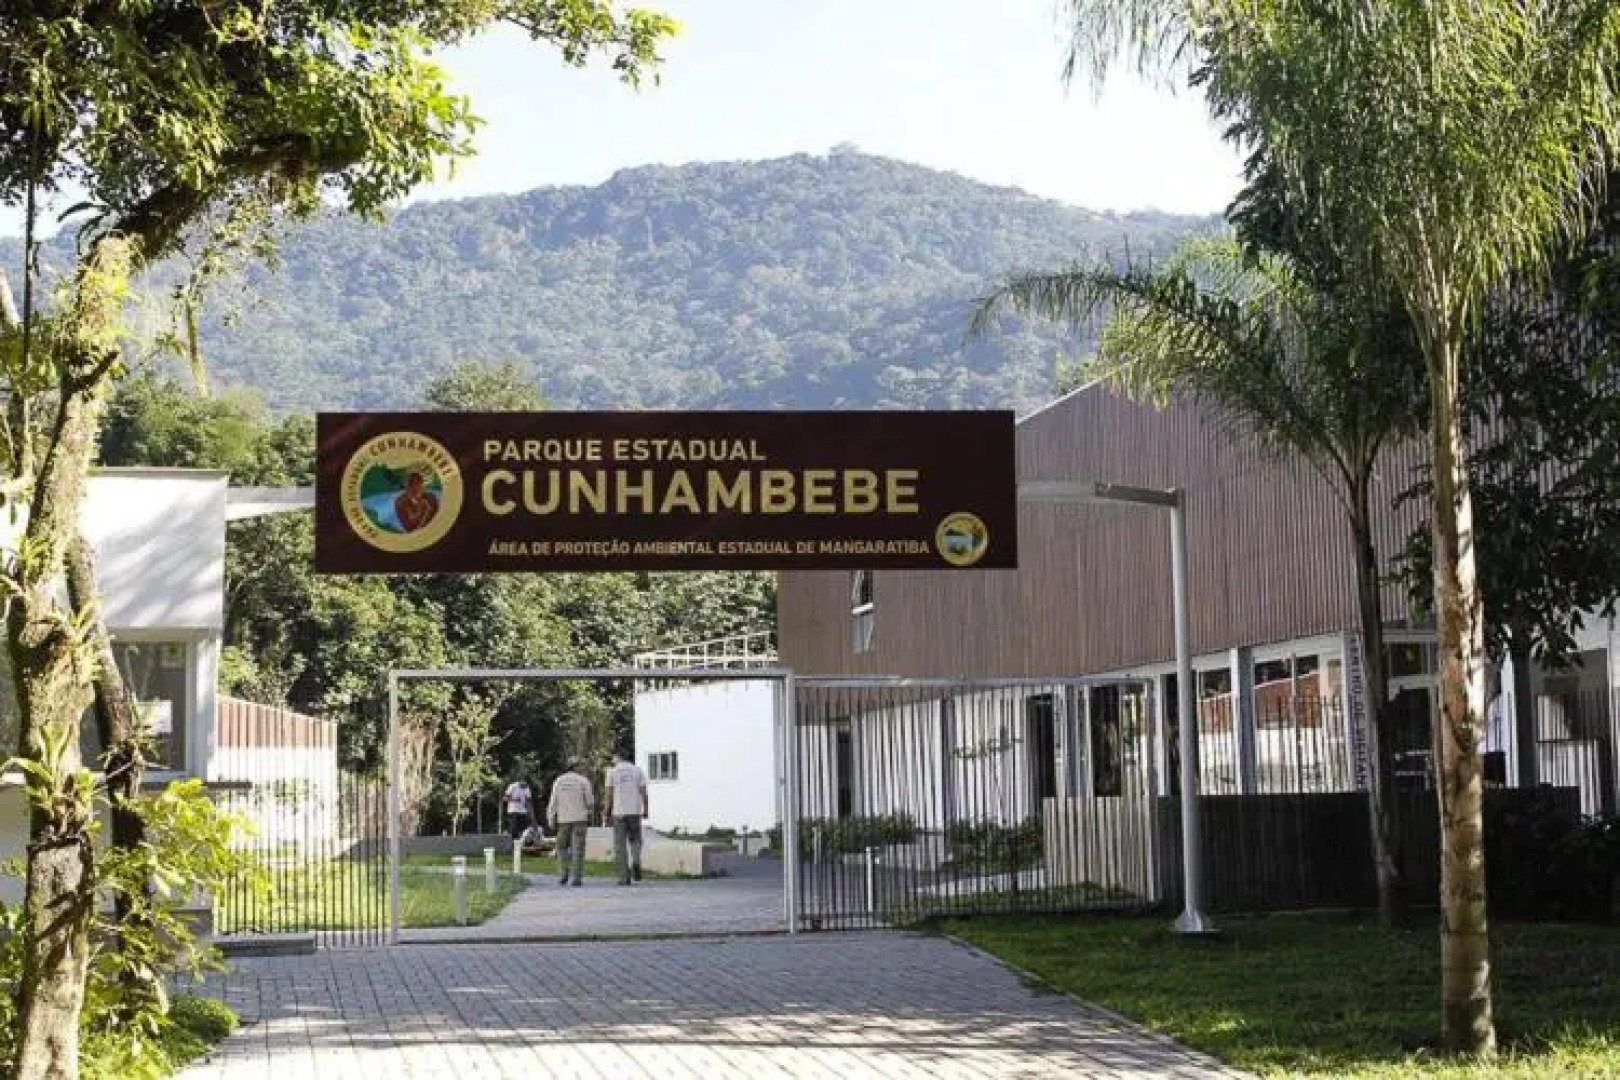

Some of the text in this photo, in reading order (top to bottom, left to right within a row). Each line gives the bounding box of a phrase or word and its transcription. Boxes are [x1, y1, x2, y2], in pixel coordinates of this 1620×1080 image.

[484, 439, 766, 461] PARQUE ESTADUAL
[481, 469, 919, 515] CUNHAMBEBE
[488, 539, 930, 557] ÁREA DE PROTEÇÃO AMBIENTAL ESTADUAL DE MANGARATIBA
